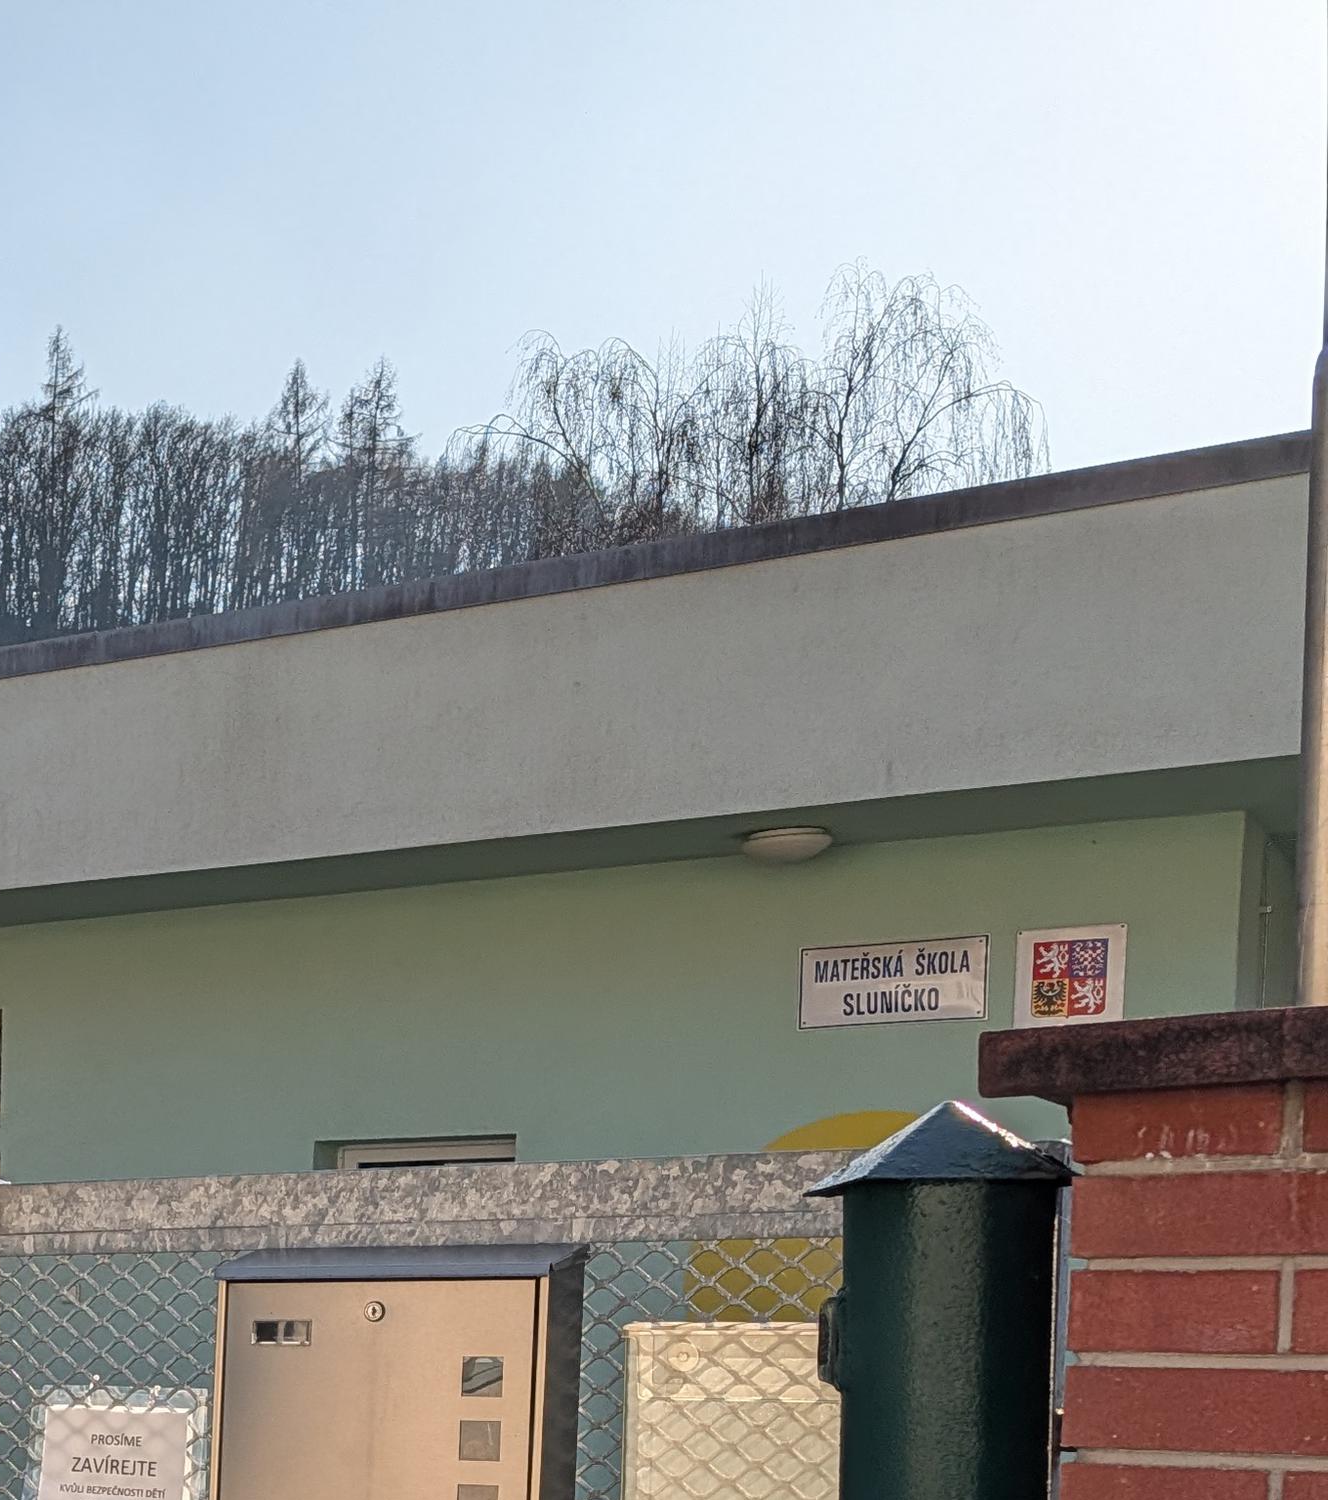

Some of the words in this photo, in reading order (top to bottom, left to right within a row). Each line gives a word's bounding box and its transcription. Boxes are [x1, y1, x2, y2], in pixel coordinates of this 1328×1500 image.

[815, 950, 903, 983] MATEŘSKÁ
[915, 948, 970, 976] ŠKOLA
[843, 984, 939, 1016] SLUNÍČKO
[90, 1433, 142, 1447] PROSÍME
[71, 1454, 157, 1477] ZAVÍREJTE
[59, 1482, 84, 1494] KVŮLI
[86, 1485, 144, 1498] BEZPEČNOSTI
[145, 1488, 166, 1499] DĚTÍ
